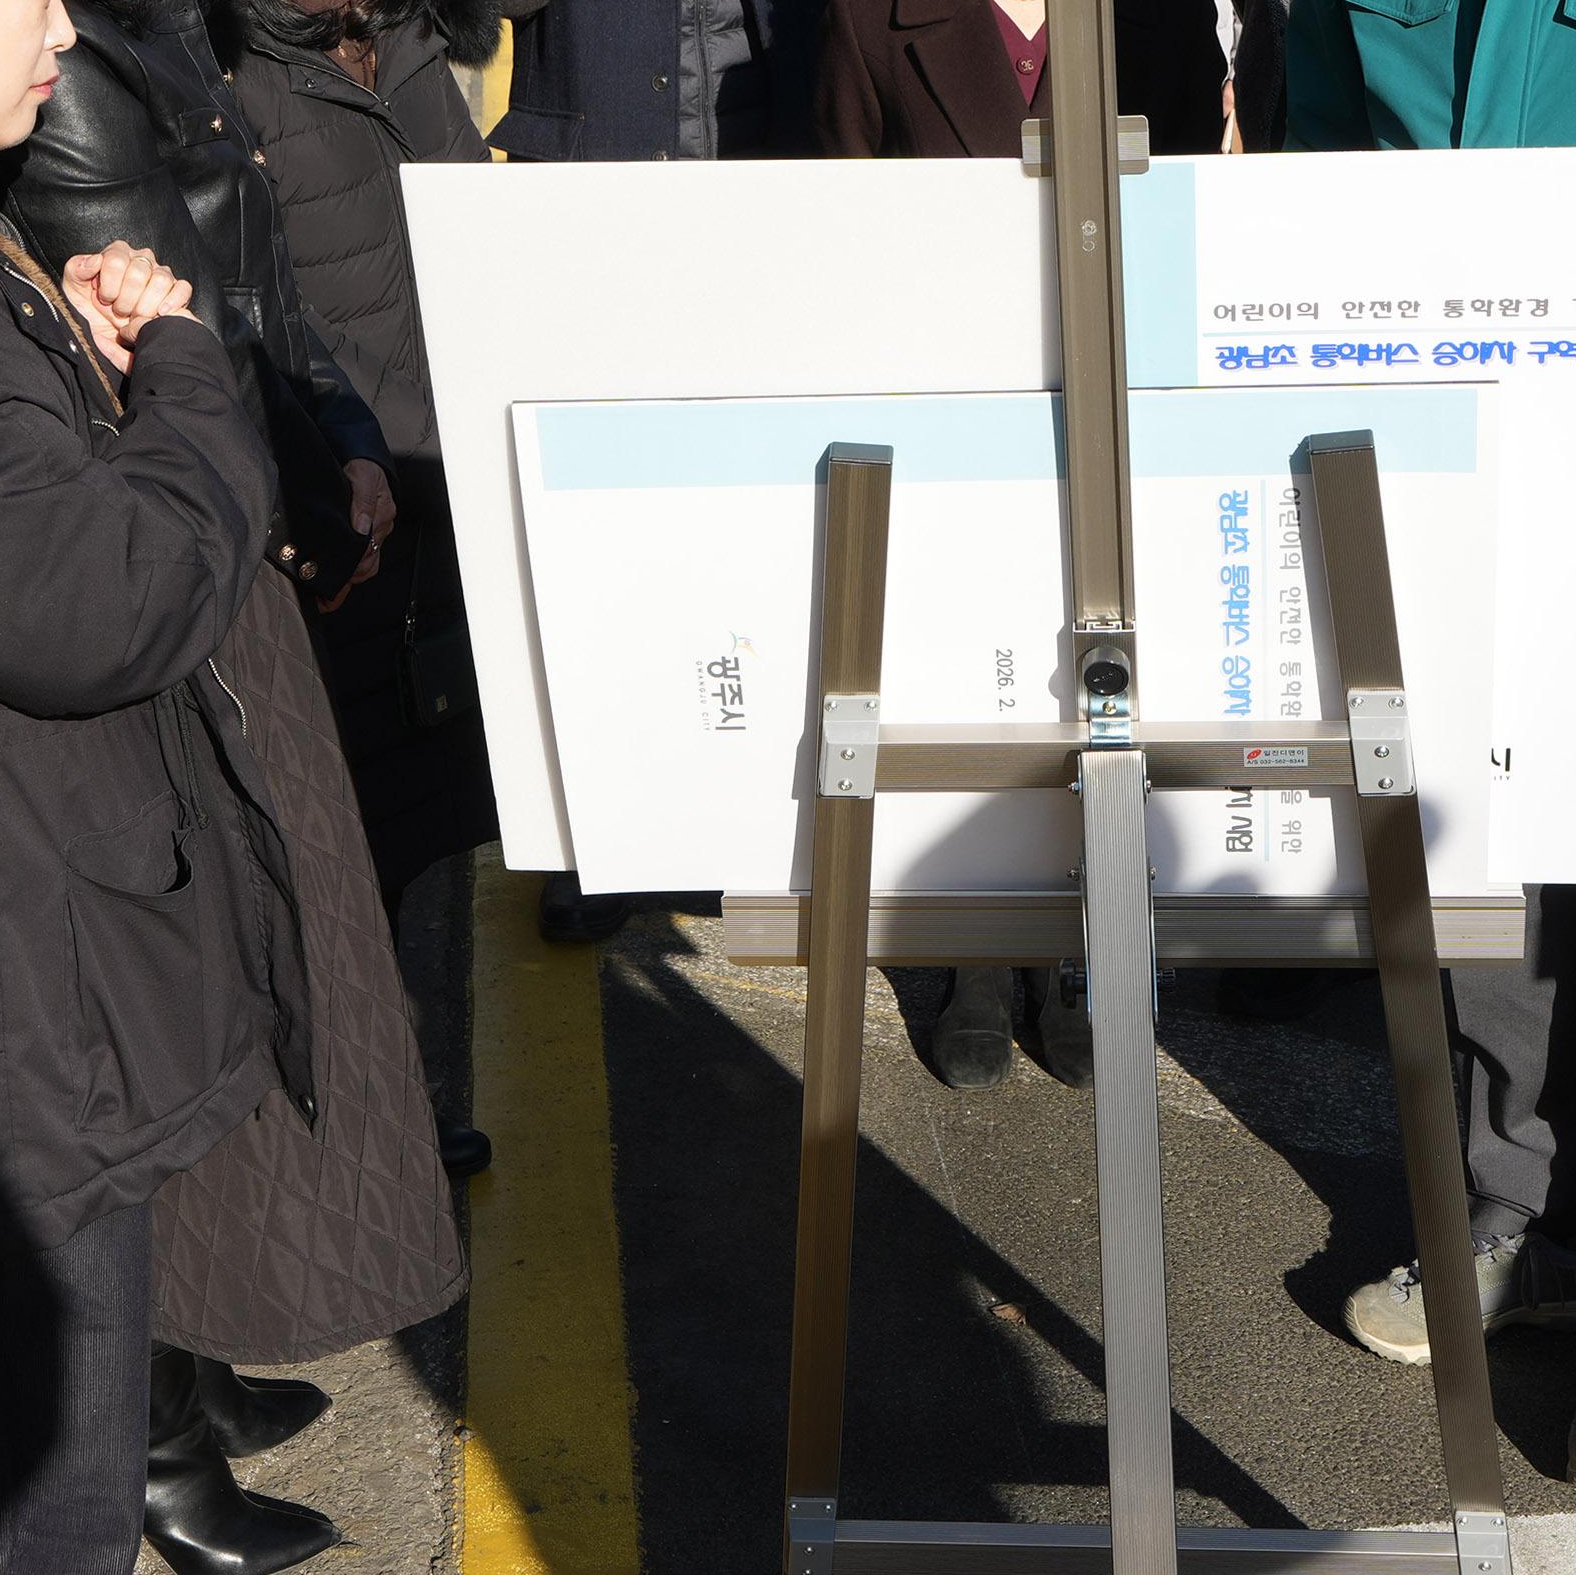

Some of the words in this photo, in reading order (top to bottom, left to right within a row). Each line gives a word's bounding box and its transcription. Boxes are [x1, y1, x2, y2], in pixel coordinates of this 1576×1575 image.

[1212, 301, 1321, 323] 어린이의
[1341, 299, 1422, 321] 안전한
[1442, 297, 1551, 319] 통학환경
[1214, 343, 1299, 370] 광남초
[1310, 342, 1422, 369] 통학버스
[1430, 340, 1518, 367] 승하차
[1218, 489, 1250, 556] 광남초
[1278, 486, 1302, 571] 어린이의
[1220, 563, 1252, 648] 통학버스
[707, 656, 747, 732] 광주시
[995, 648, 1017, 691] 2026.
[1221, 654, 1253, 717] 승하차
[1279, 660, 1303, 718] 통학환
[998, 697, 1016, 713] 2.
[1225, 815, 1254, 853] 사업
